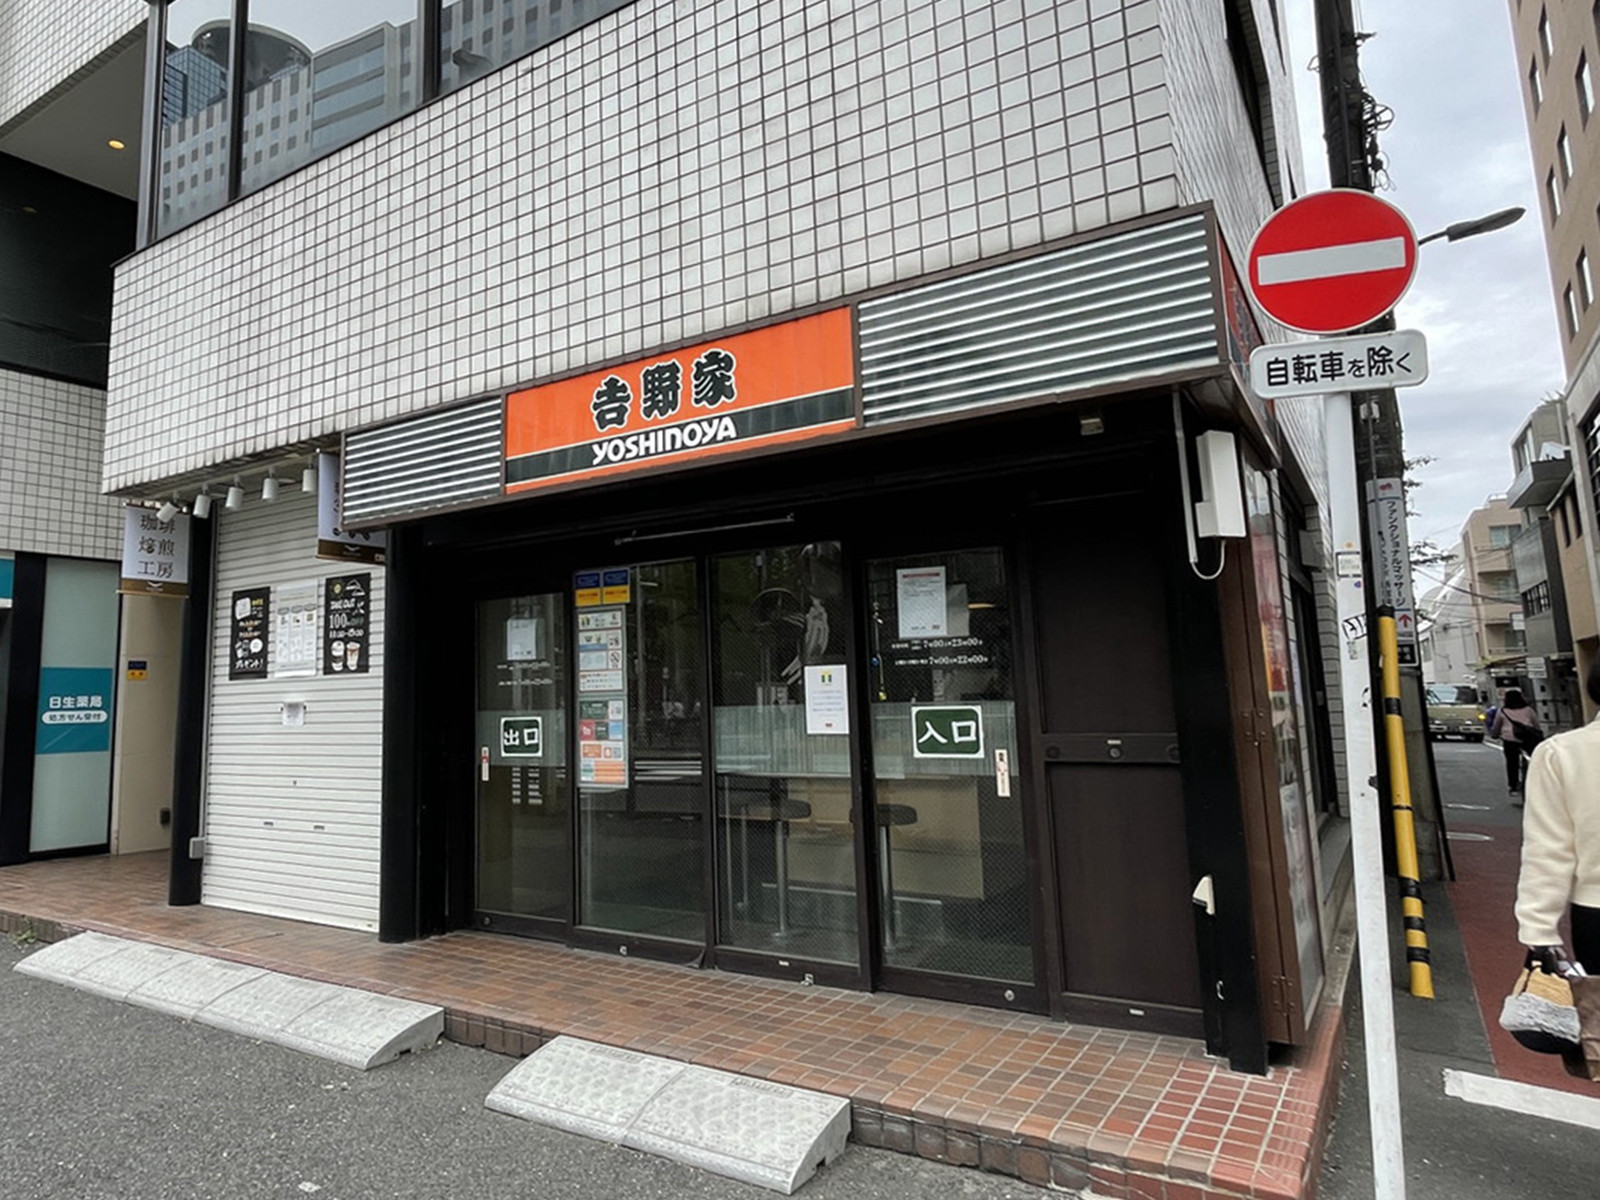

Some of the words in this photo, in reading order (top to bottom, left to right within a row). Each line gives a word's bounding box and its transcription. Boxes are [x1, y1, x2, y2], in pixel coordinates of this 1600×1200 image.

[1266, 345, 1412, 387] 自転車を除く
[592, 416, 737, 466] YOSHINOYA
[1386, 501, 1406, 607] ファンクショナルマッサージ
[137, 561, 173, 579] 工房
[49, 695, 102, 709] 日生薬局
[503, 728, 539, 746] 出口
[918, 721, 977, 744] 入口
